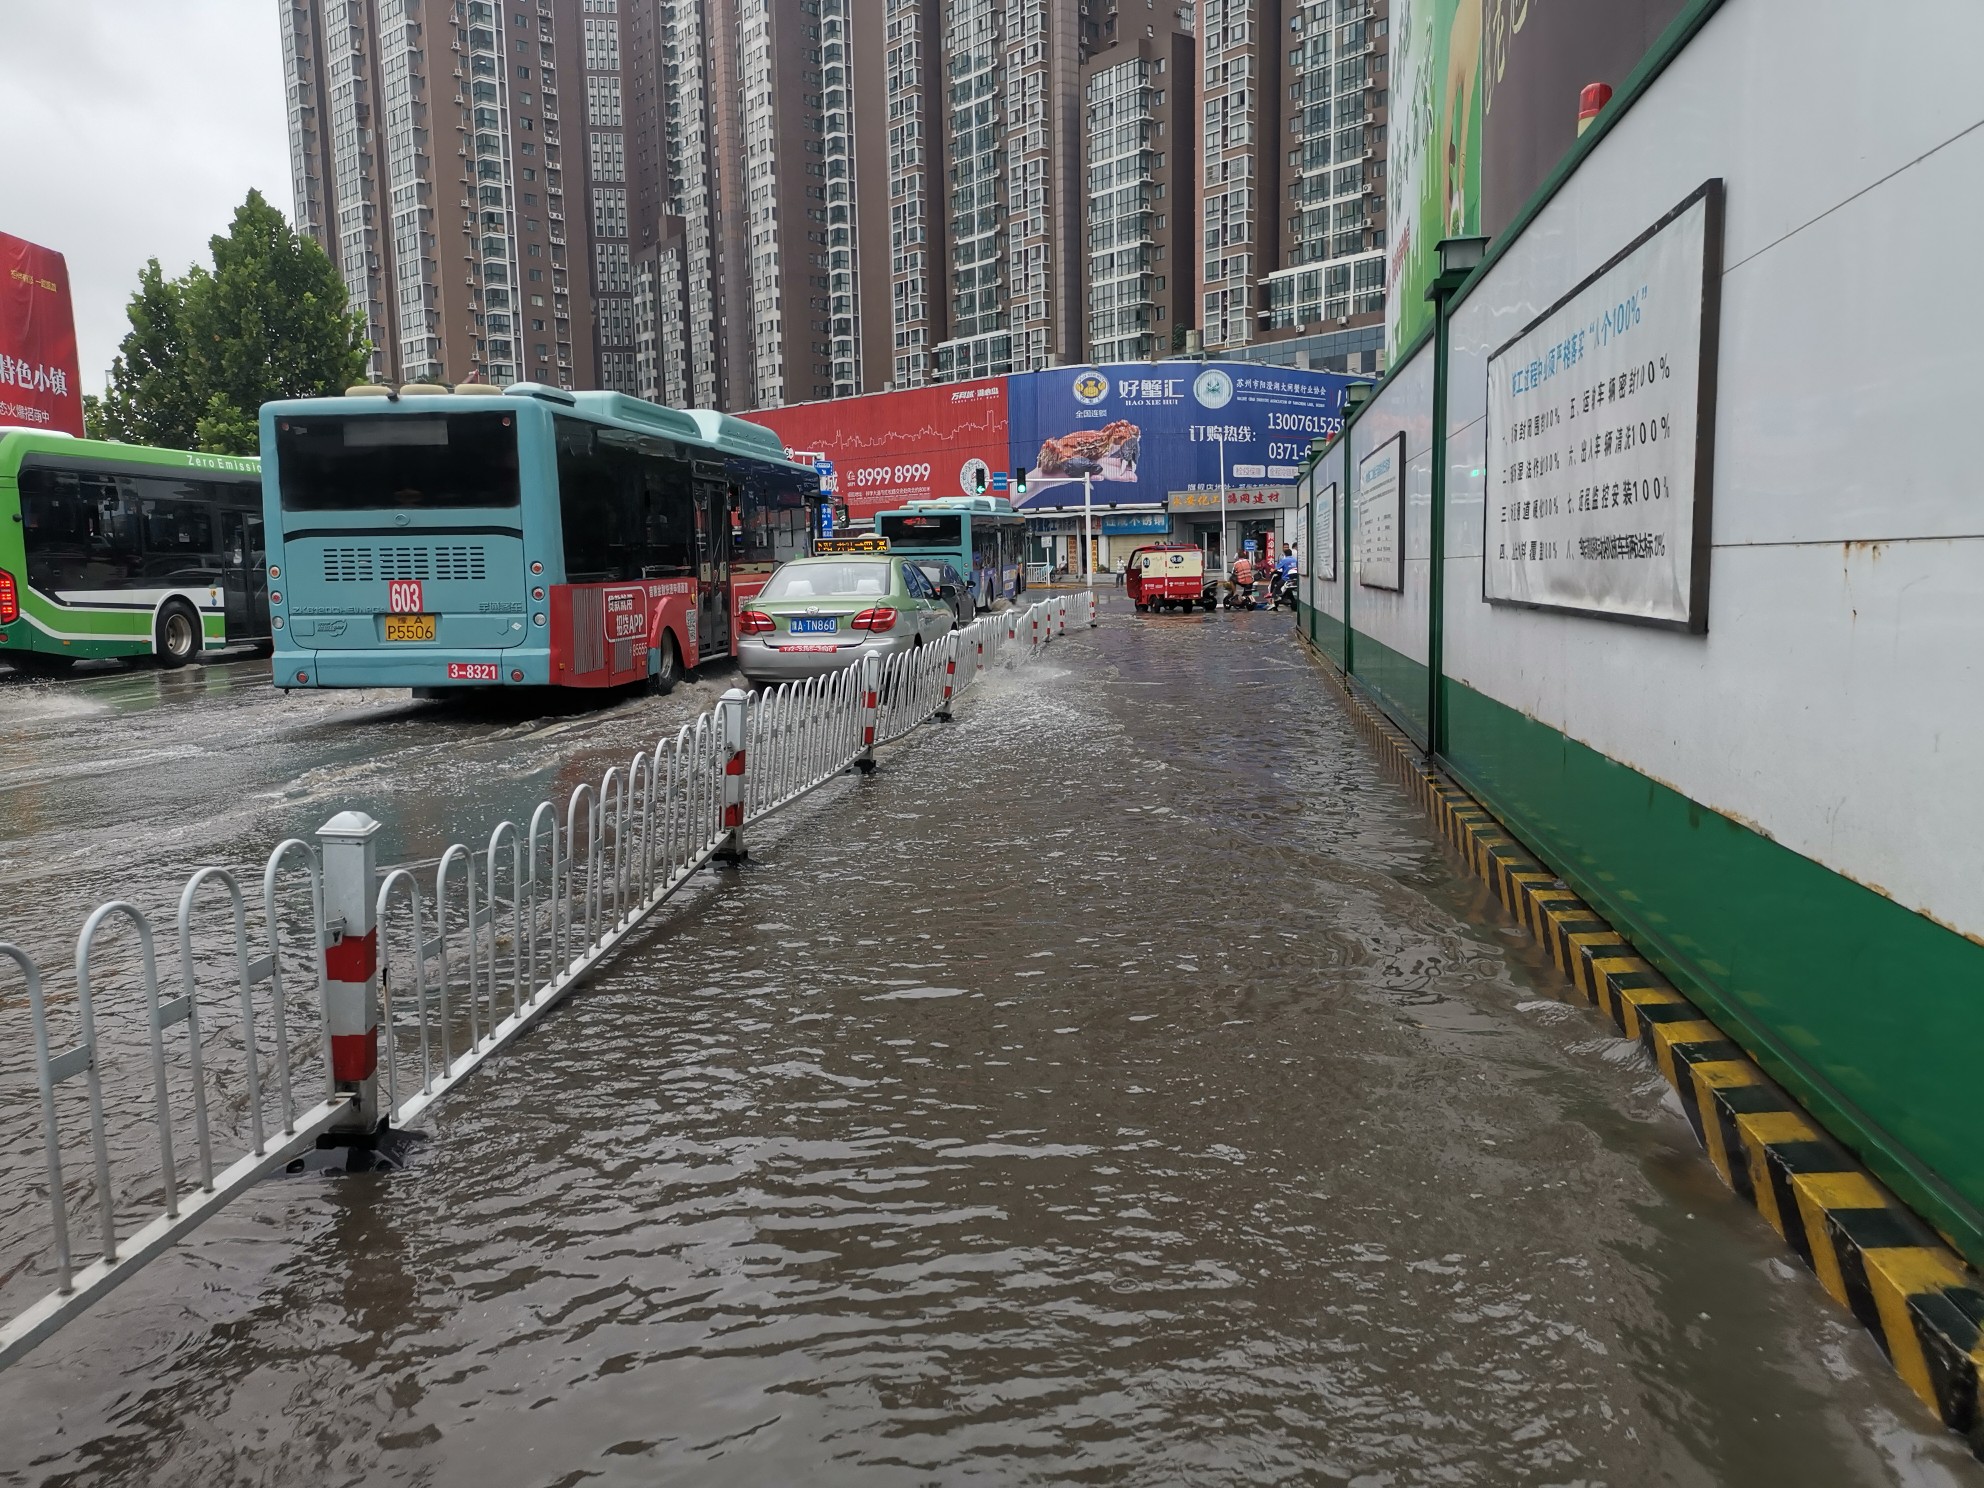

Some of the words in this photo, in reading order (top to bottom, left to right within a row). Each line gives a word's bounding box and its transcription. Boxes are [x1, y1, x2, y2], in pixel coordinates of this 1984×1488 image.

[0, 353, 68, 397] 特色小镇
[1118, 379, 1185, 398] 好蟹汇
[1075, 410, 1107, 418] 全国连锁
[186, 455, 215, 468] Zero
[857, 466, 891, 487] 8999
[894, 463, 931, 483] 8999
[391, 583, 420, 613] 603
[388, 625, 434, 640] P5506
[450, 663, 497, 679] 3-8321
